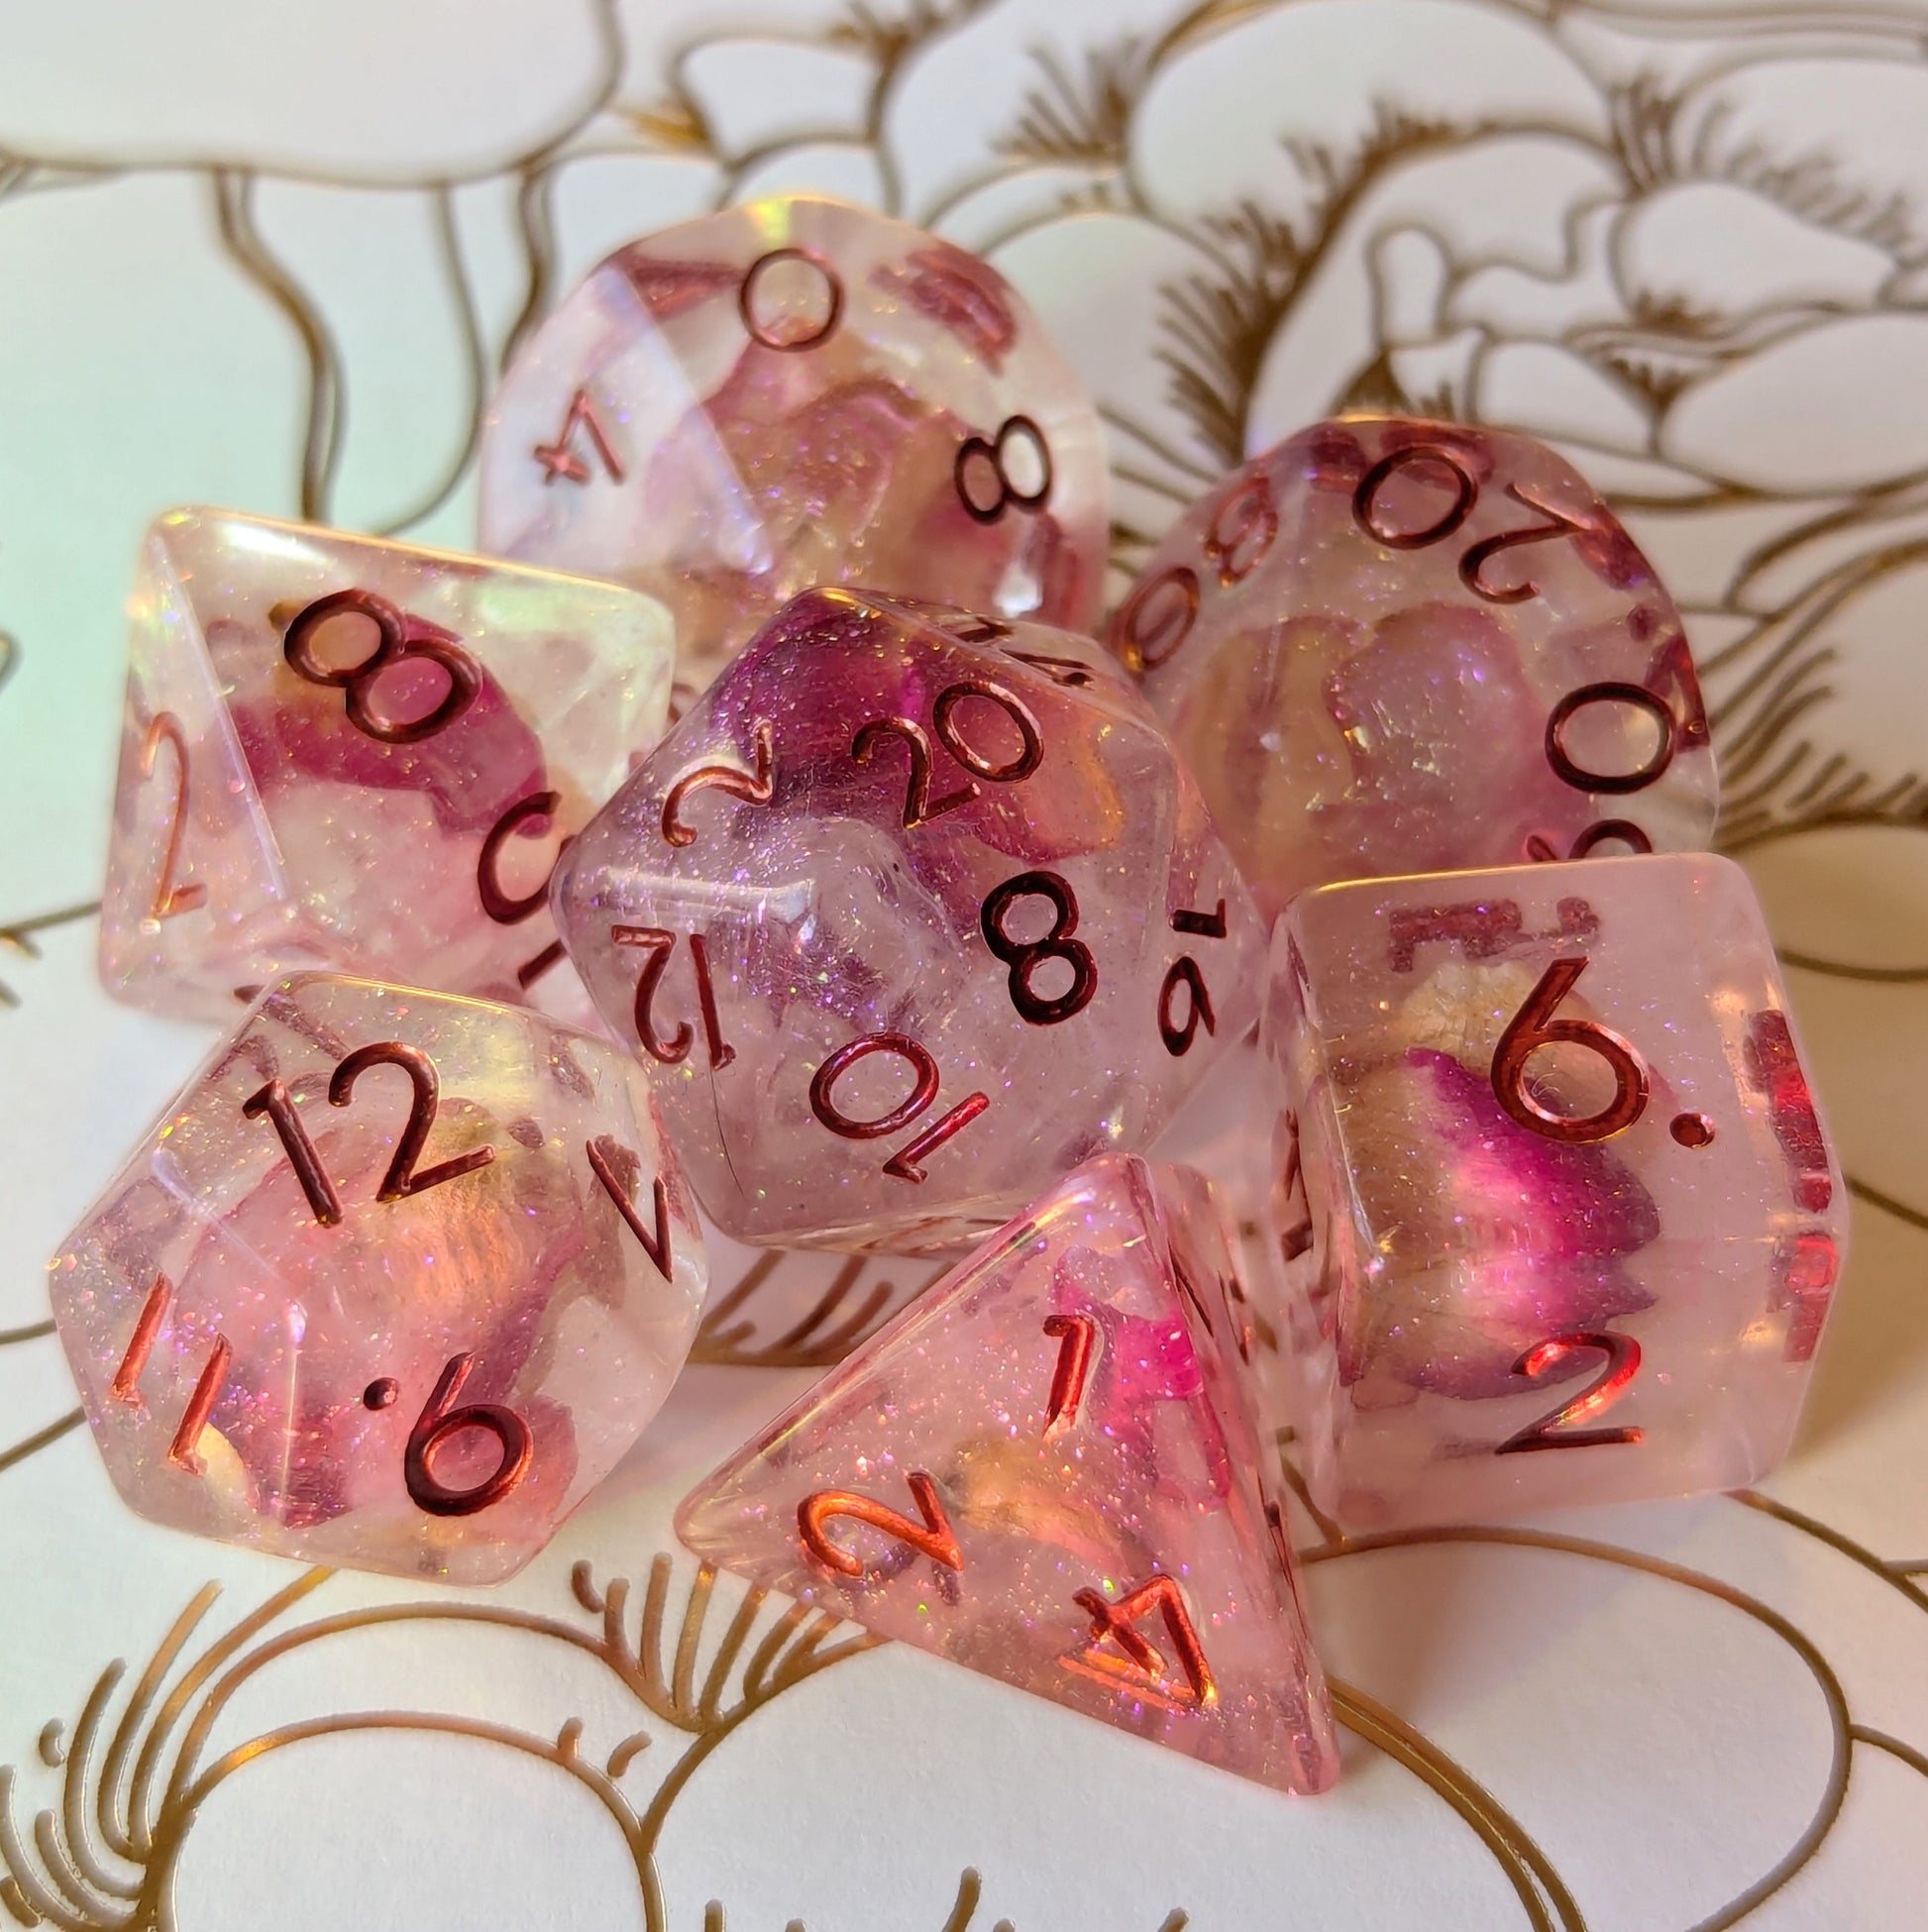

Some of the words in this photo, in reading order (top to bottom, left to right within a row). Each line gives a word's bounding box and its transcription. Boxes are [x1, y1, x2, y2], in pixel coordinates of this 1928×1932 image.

[740, 248, 843, 352] 0
[533, 388, 626, 485] 4
[953, 414, 1052, 524] 8
[283, 588, 483, 745] 8
[142, 711, 208, 919] 2
[662, 720, 773, 848] 2
[851, 681, 1045, 829] 20
[610, 924, 737, 1072] 12
[980, 870, 1099, 1026] 8
[242, 1041, 494, 1229] 12
[809, 1031, 991, 1185] 10
[1041, 1314, 1098, 1441] 1
[1495, 1331, 1645, 1454] 2
[797, 1471, 964, 1577] 2
[1073, 1573, 1220, 1709] 4
